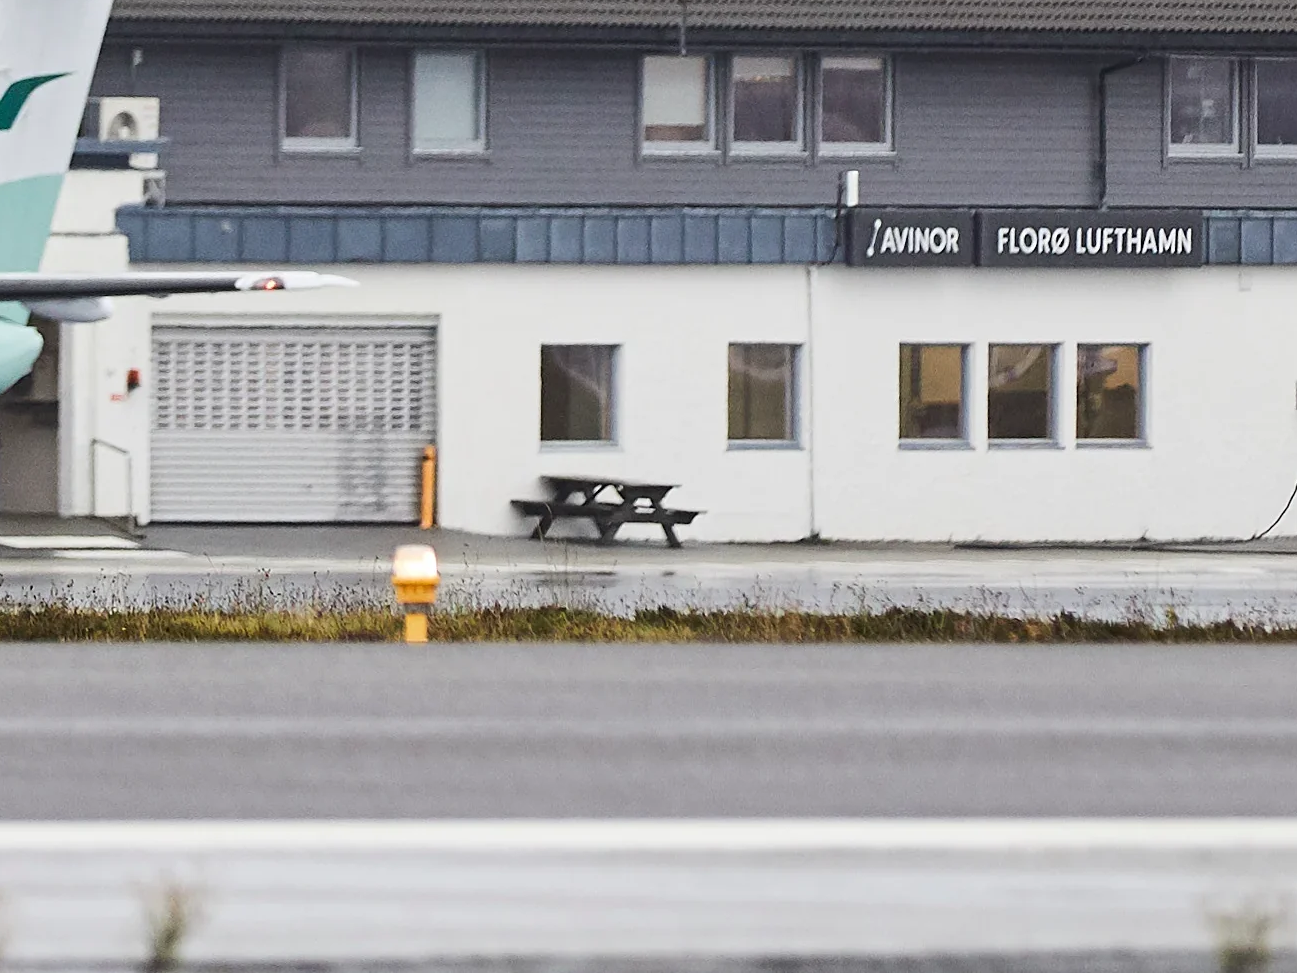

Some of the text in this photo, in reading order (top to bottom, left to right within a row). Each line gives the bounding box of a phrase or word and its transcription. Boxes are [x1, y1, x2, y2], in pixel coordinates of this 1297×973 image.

[880, 226, 960, 255] AVINOR
[998, 226, 1193, 256] FLORØ LUFTHAMN
